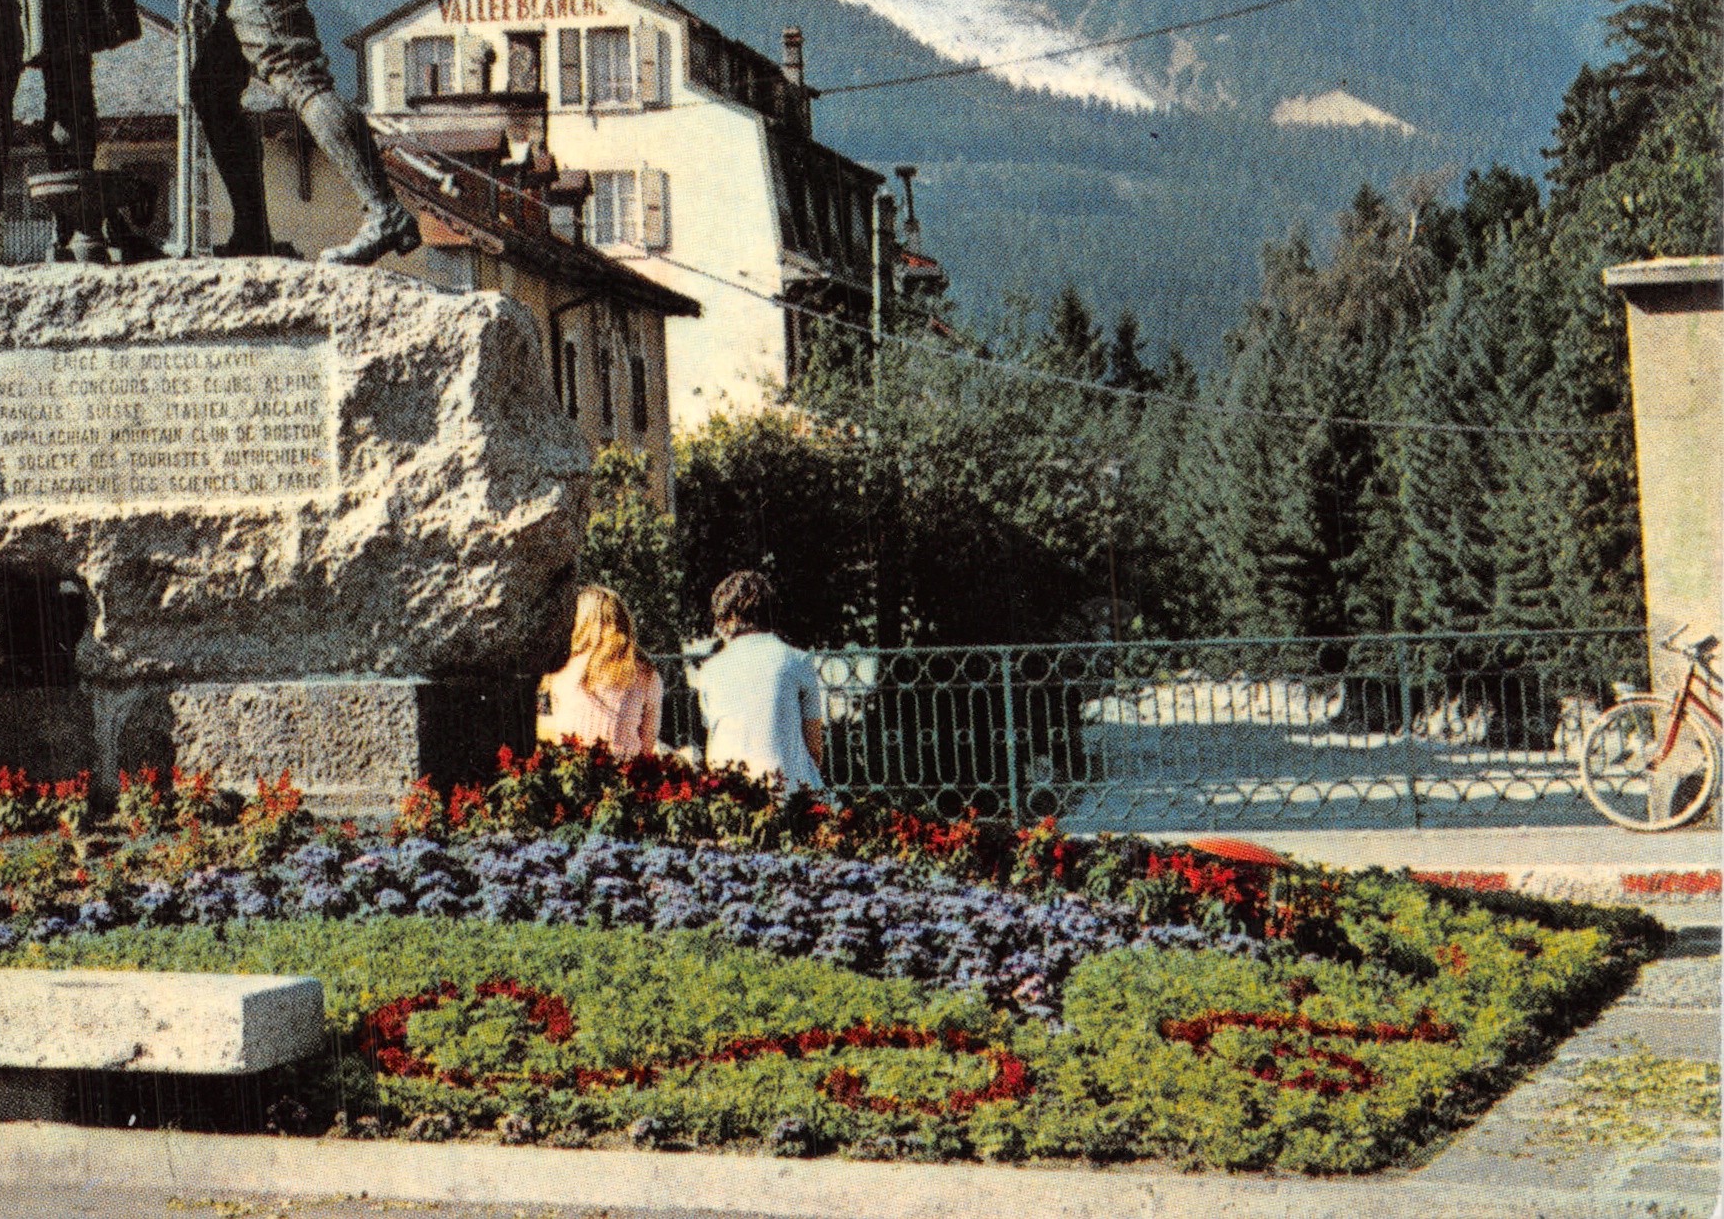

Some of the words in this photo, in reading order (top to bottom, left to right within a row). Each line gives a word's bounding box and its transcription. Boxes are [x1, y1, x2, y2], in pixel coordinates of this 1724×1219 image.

[38, 380, 56, 397] LE
[69, 378, 149, 396] CONCOURS
[161, 377, 191, 395] DES
[204, 376, 252, 395] CLUBS
[264, 374, 322, 393] ALPINS
[110, 427, 182, 446] MOUNTAIN
[192, 426, 229, 443] CLUB
[236, 425, 255, 443] DE
[262, 424, 323, 442] BOSTON
[90, 452, 118, 470] DES
[131, 450, 210, 469] TOURISTES
[13, 478, 33, 495] DE
[169, 474, 239, 493] SCIENCES
[249, 474, 267, 491] DE
[278, 472, 322, 490] PARIS
